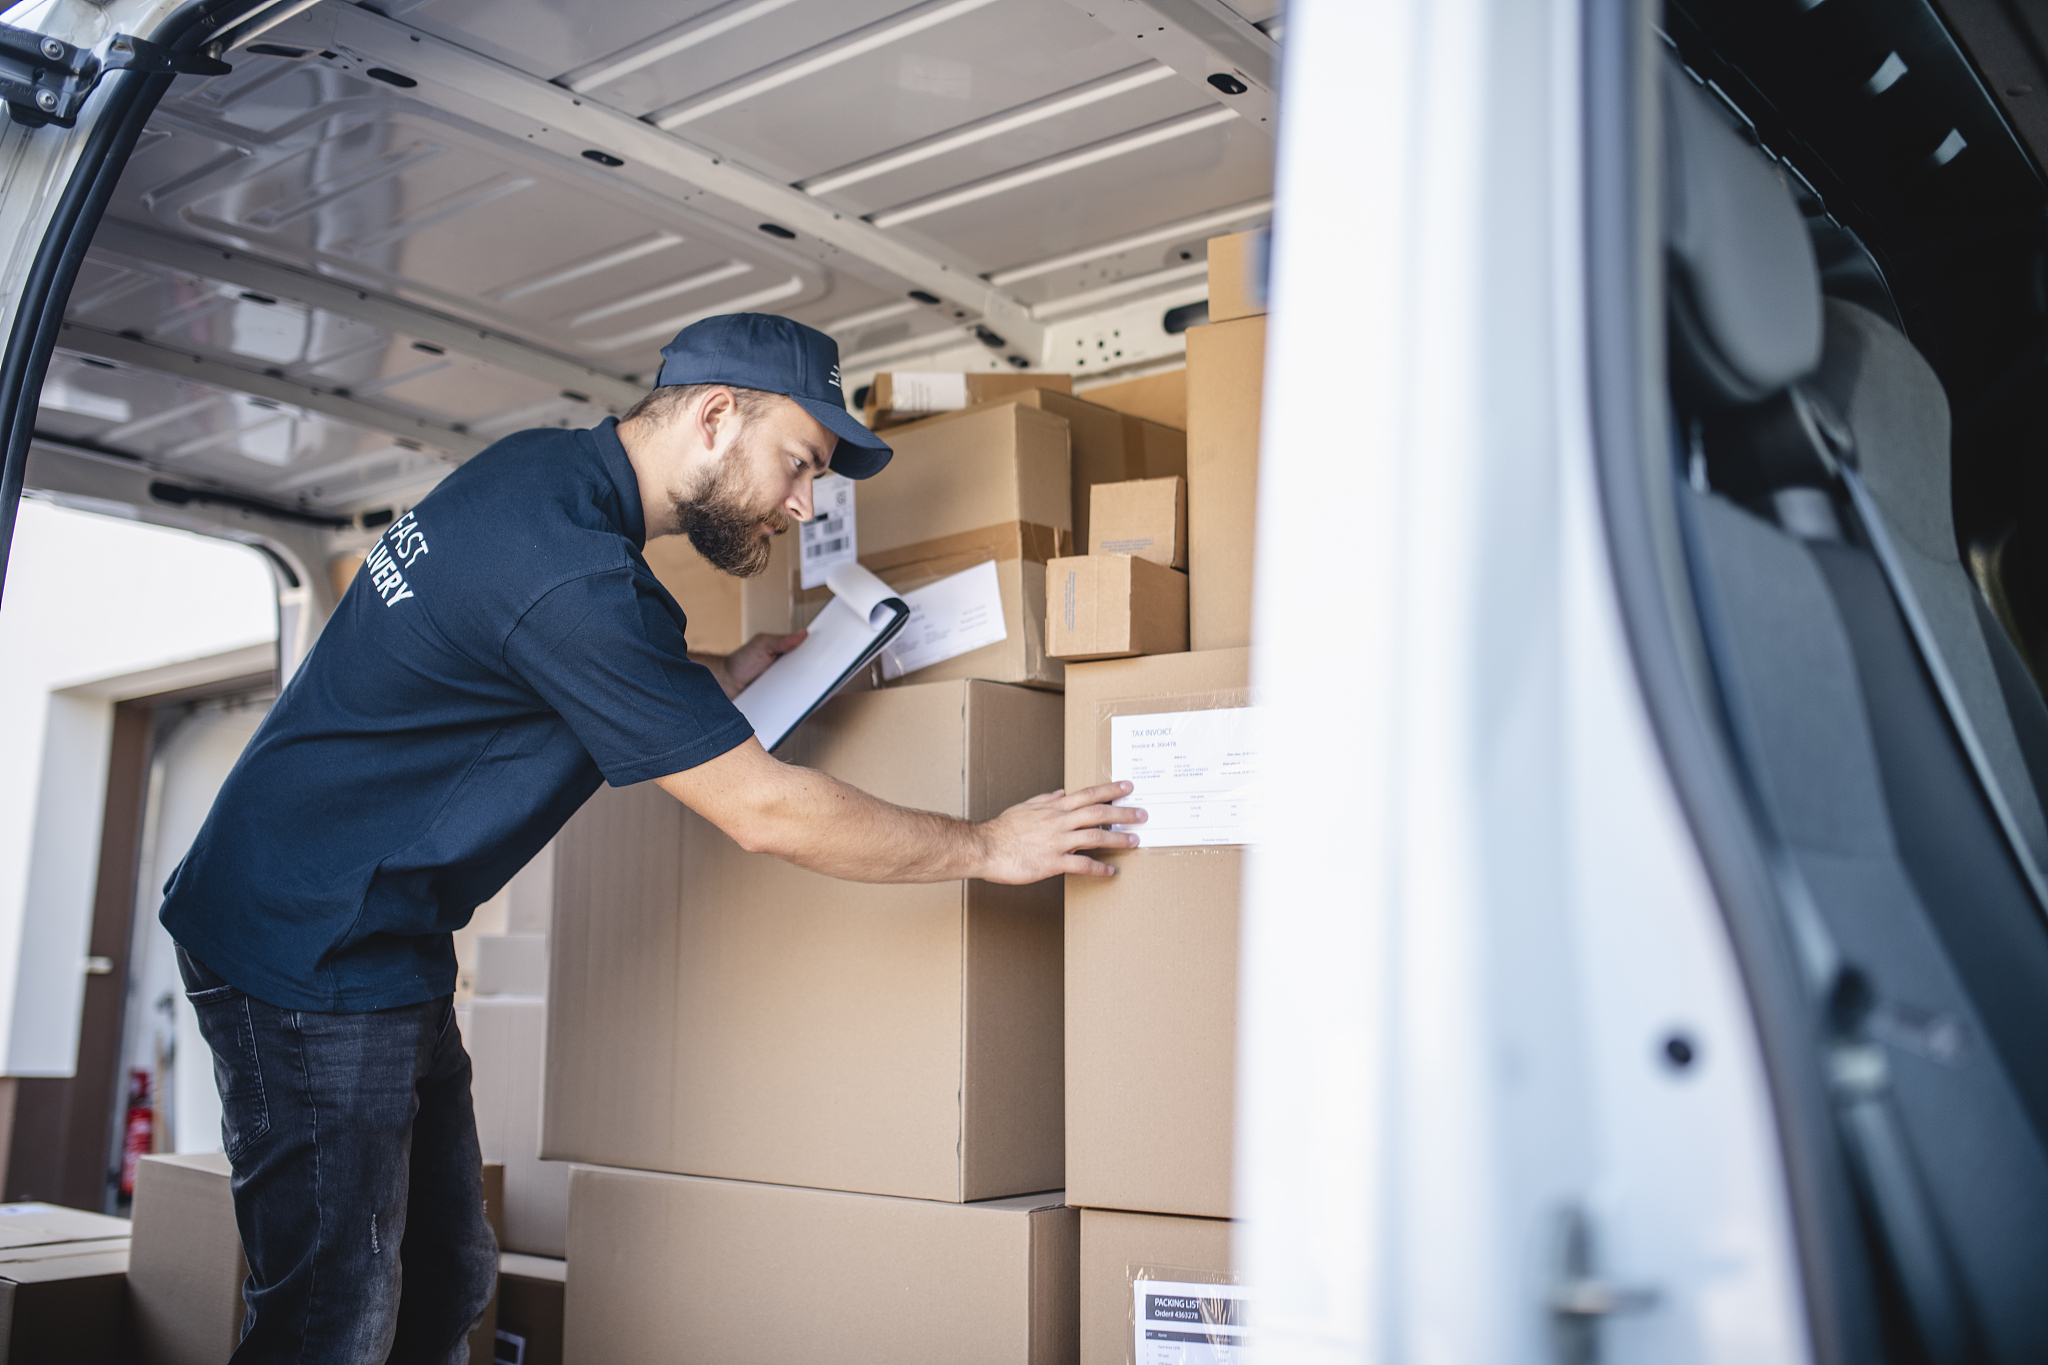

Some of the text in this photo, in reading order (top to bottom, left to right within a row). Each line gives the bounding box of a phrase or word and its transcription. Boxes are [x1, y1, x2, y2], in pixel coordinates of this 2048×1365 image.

[388, 511, 429, 569] FAST
[366, 537, 414, 607] LIVERY
[1132, 727, 1173, 737] TAX INVOICE
[1154, 1297, 1200, 1310] PACKING LIST
